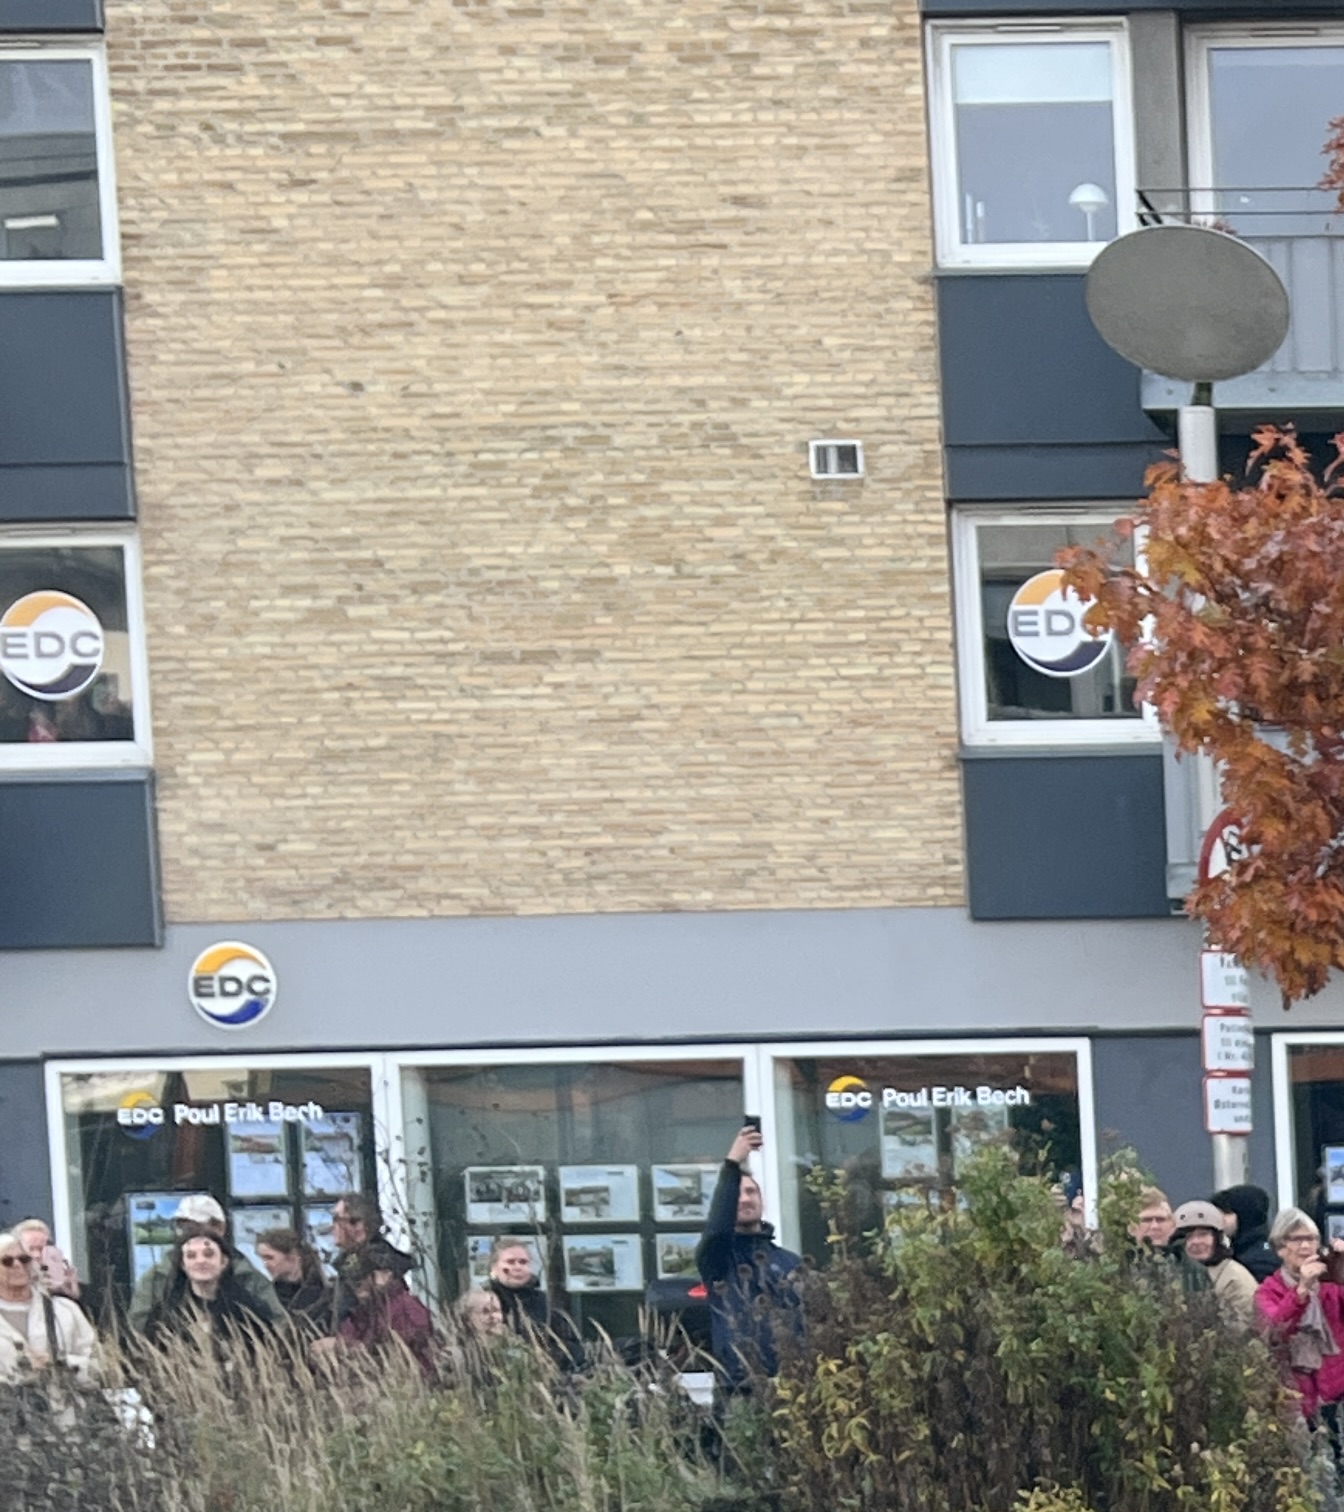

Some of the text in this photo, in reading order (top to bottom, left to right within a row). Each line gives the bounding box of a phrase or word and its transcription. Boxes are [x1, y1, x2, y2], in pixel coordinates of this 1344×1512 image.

[1012, 609, 1076, 637] ED
[0, 631, 100, 659] EDC
[193, 975, 270, 998] EDC
[825, 1085, 1030, 1108] EDC Poul Erik Bech
[117, 1101, 323, 1125] EDC Poul Erik Bech
